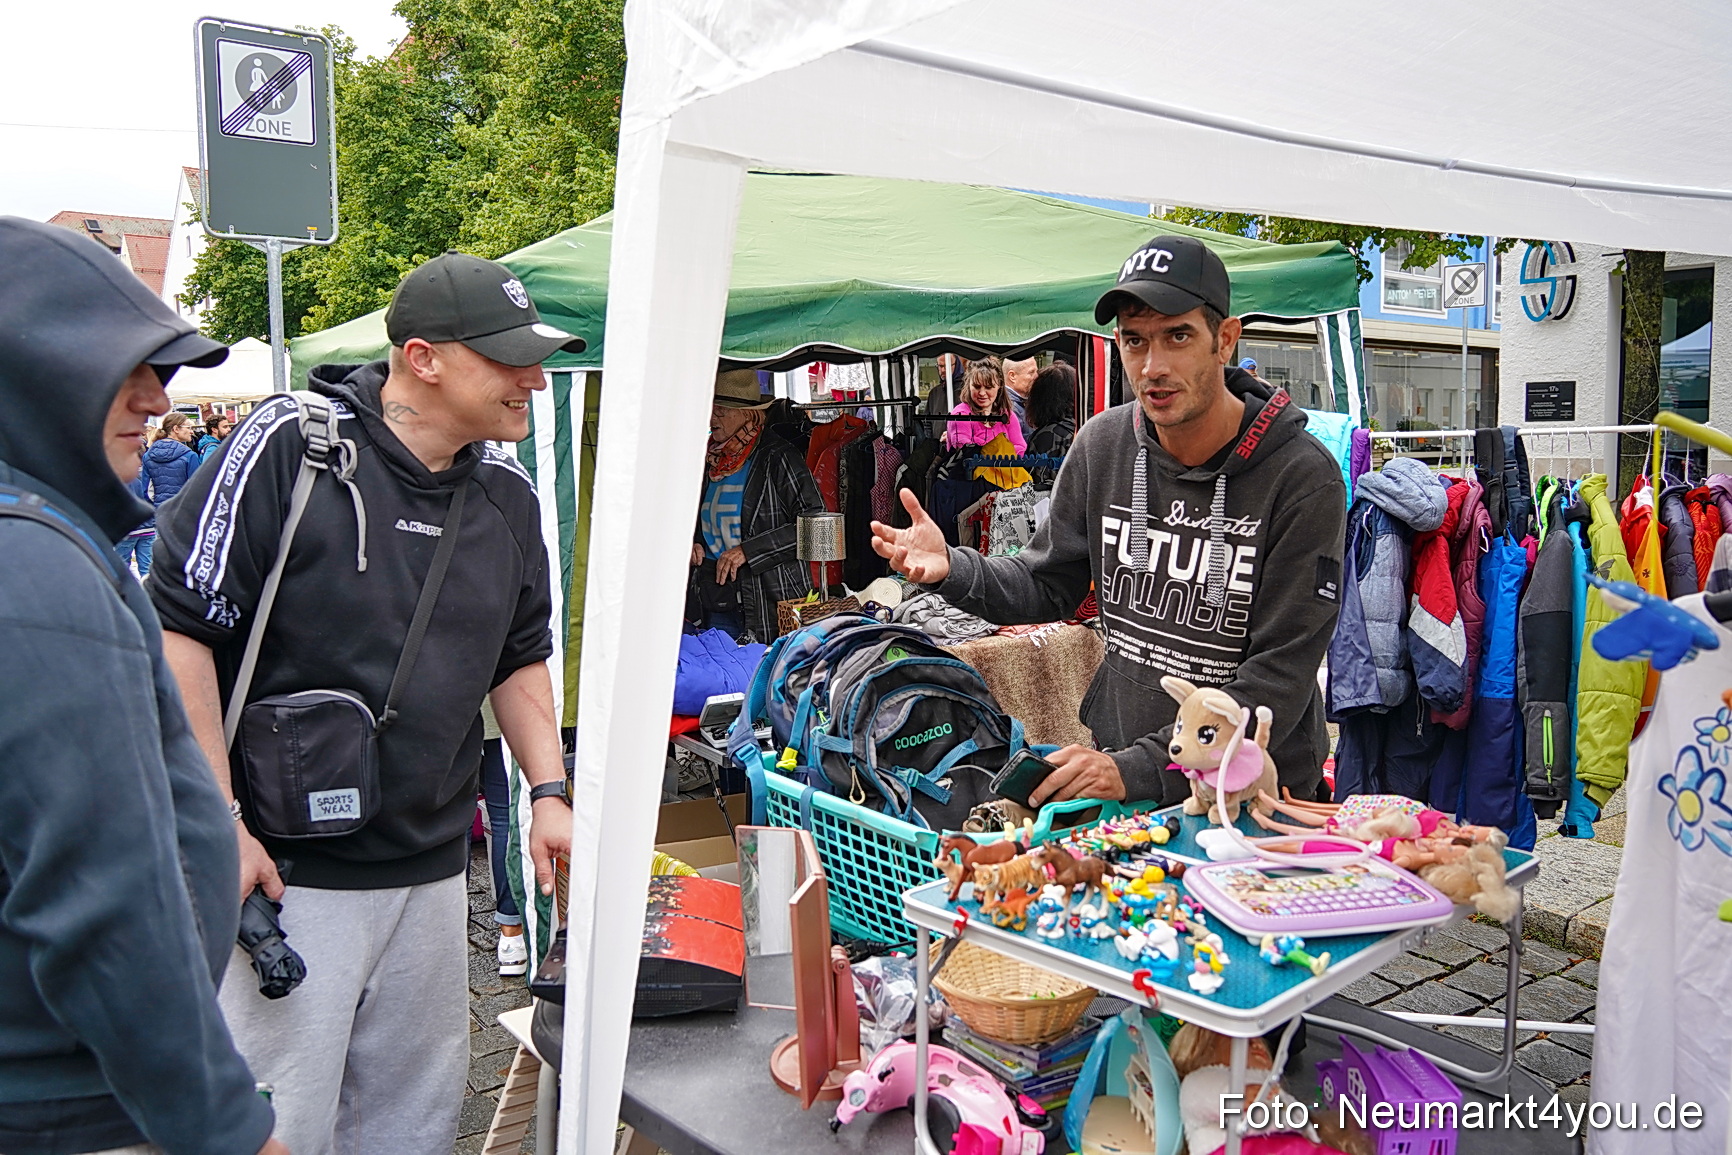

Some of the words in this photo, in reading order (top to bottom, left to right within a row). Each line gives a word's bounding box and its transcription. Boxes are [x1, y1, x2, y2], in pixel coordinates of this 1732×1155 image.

[245, 117, 292, 136] ZONE
[1119, 248, 1173, 282] NYC
[1454, 297, 1475, 305] ZONE
[1235, 405, 1280, 459] FUTURE
[225, 423, 263, 487] Kappa
[409, 520, 444, 537] Kapp
[195, 517, 227, 585] Kappa
[1147, 642, 1154, 650] IS
[1154, 645, 1171, 655] ONLY
[1172, 650, 1190, 661] YOUR
[1145, 659, 1151, 667] A
[1152, 661, 1167, 671] NEW
[1166, 666, 1206, 682] DISTORTED
[1202, 666, 1213, 675] GO
[1213, 668, 1230, 676] FOR
[316, 794, 354, 807] SPORTS
[321, 805, 352, 815] WEAR
